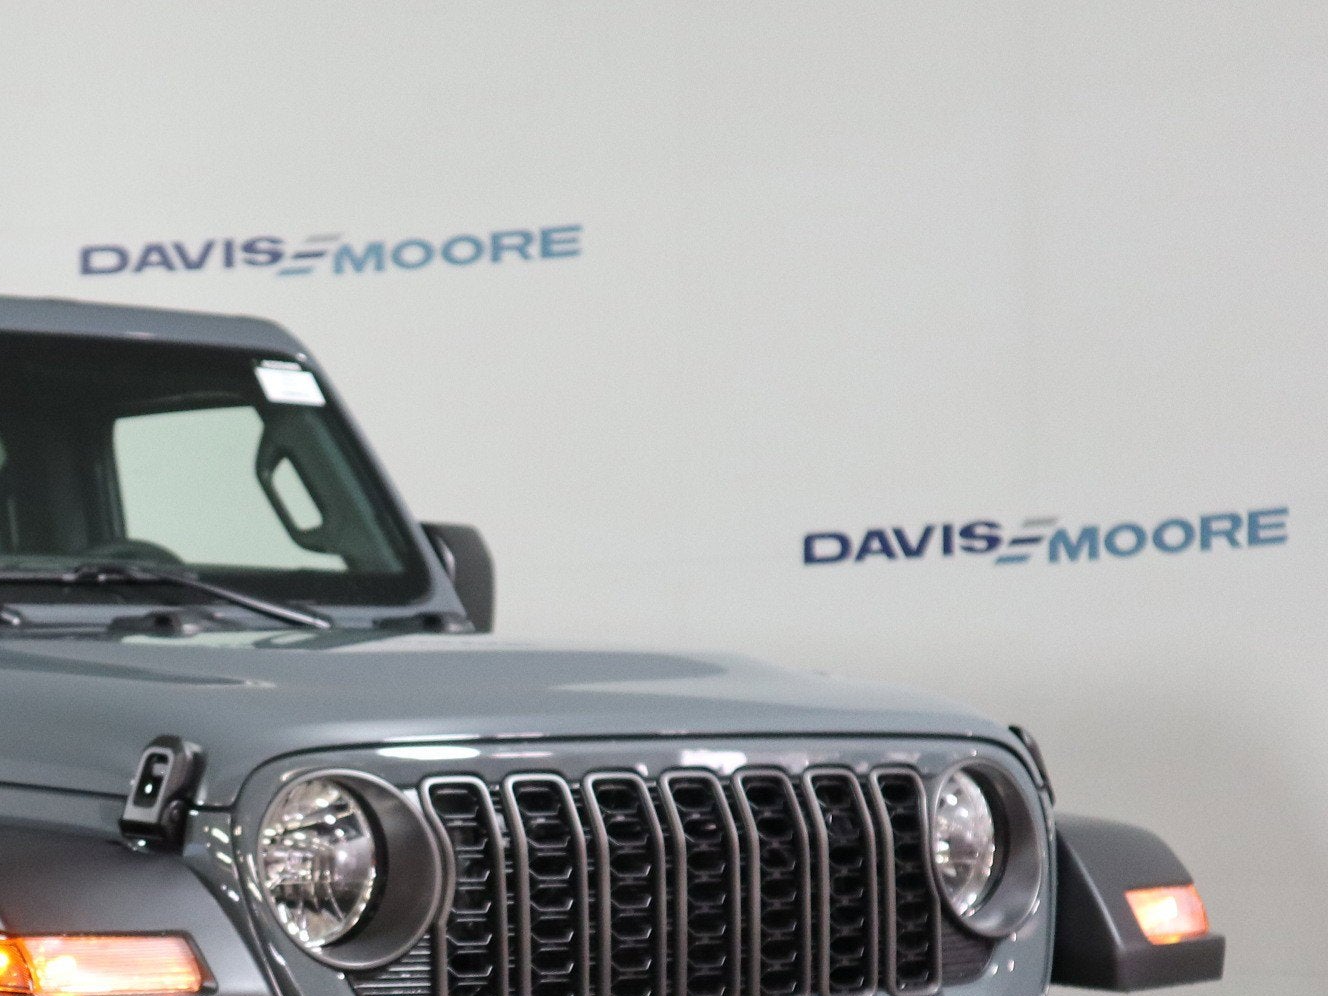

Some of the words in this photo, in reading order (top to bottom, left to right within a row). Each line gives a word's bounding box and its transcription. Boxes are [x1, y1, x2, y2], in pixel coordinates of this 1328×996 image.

[79, 235, 284, 276] DAVIS
[333, 224, 583, 276] MOORE
[803, 520, 1002, 566] DAVIS
[1048, 507, 1290, 563] MOORE
